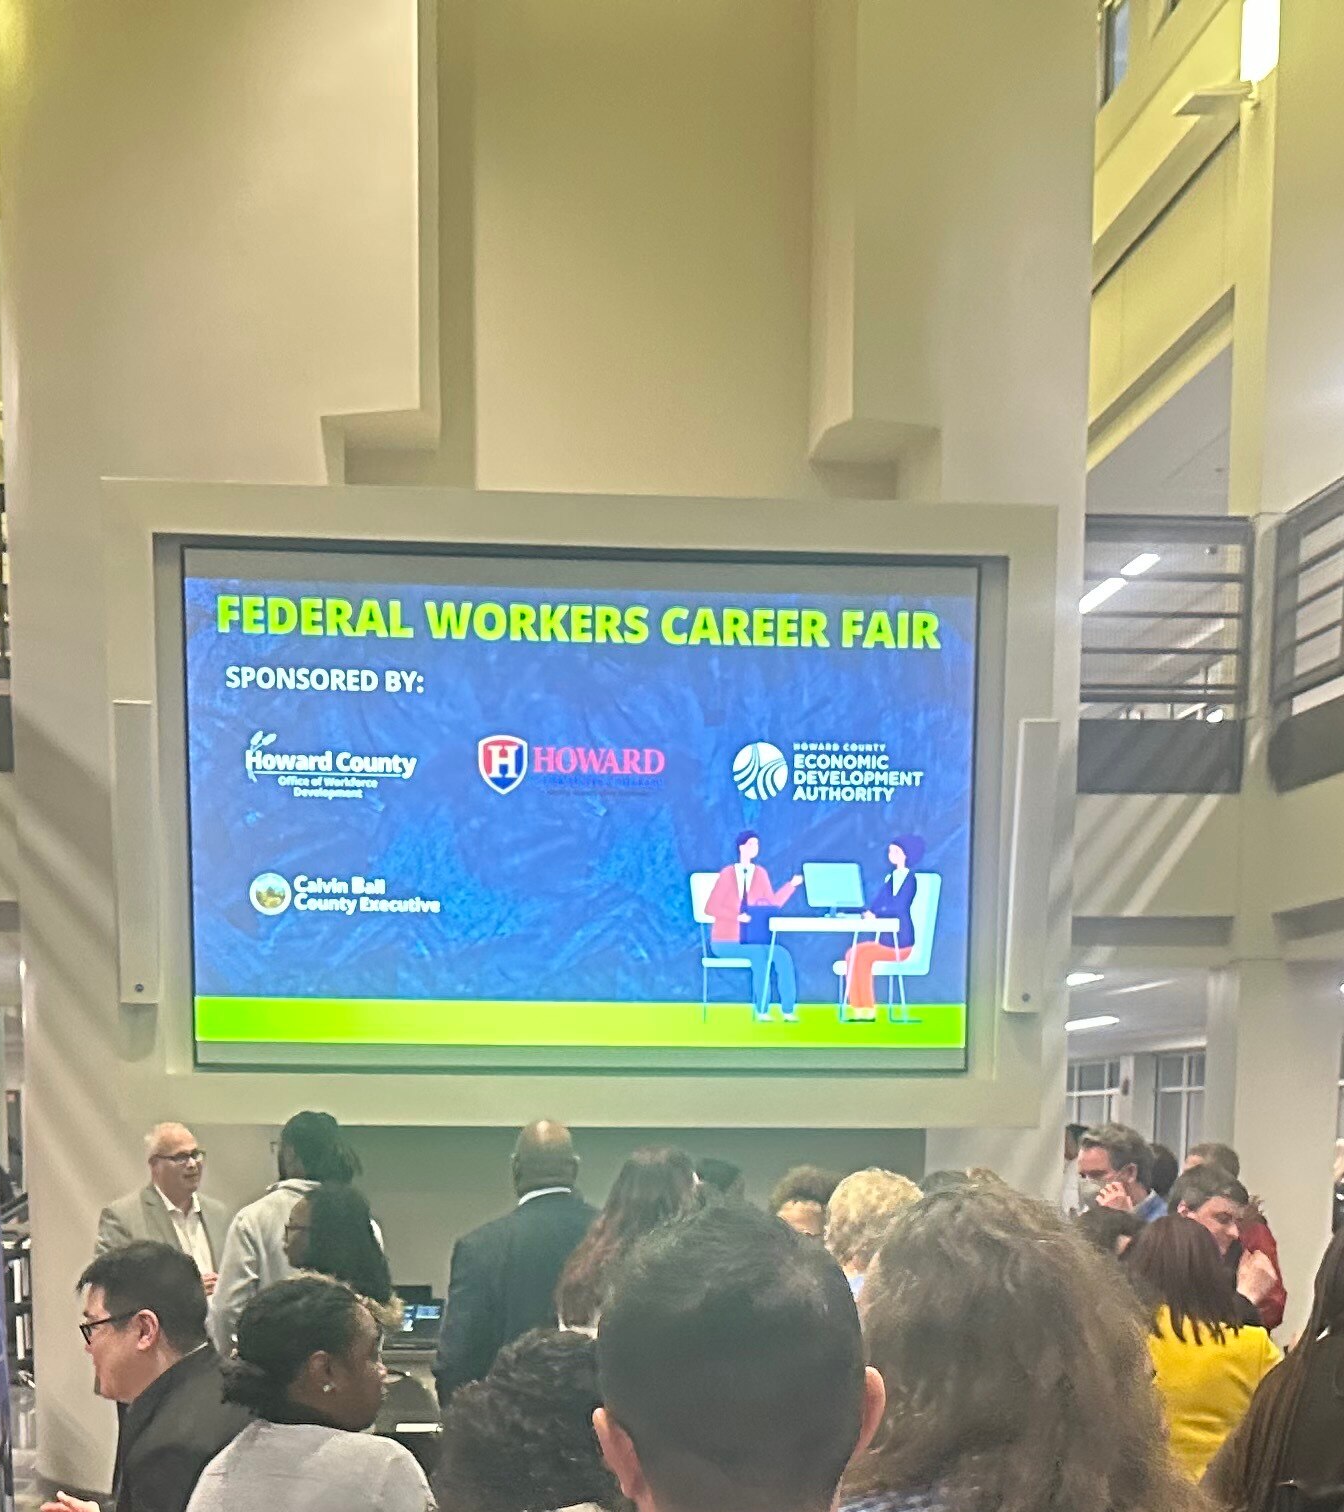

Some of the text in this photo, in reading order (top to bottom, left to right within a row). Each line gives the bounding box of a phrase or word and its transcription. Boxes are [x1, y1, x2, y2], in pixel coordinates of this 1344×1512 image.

[217, 594, 941, 649] FEDERAL WORKERS CAREER FAIR
[225, 665, 424, 694] SPONSORED BY:
[793, 742, 886, 752] HOWARD COUNTY
[245, 749, 418, 779] Howard County
[533, 746, 666, 775] HOWARD
[793, 753, 889, 770] ECONOMIC
[277, 776, 378, 789] Office of Workforce
[793, 770, 924, 787] DEVELOPMENT
[793, 786, 895, 803] AUTHORITY
[293, 874, 386, 895] Calvin Ball
[293, 892, 441, 916] County Executive
